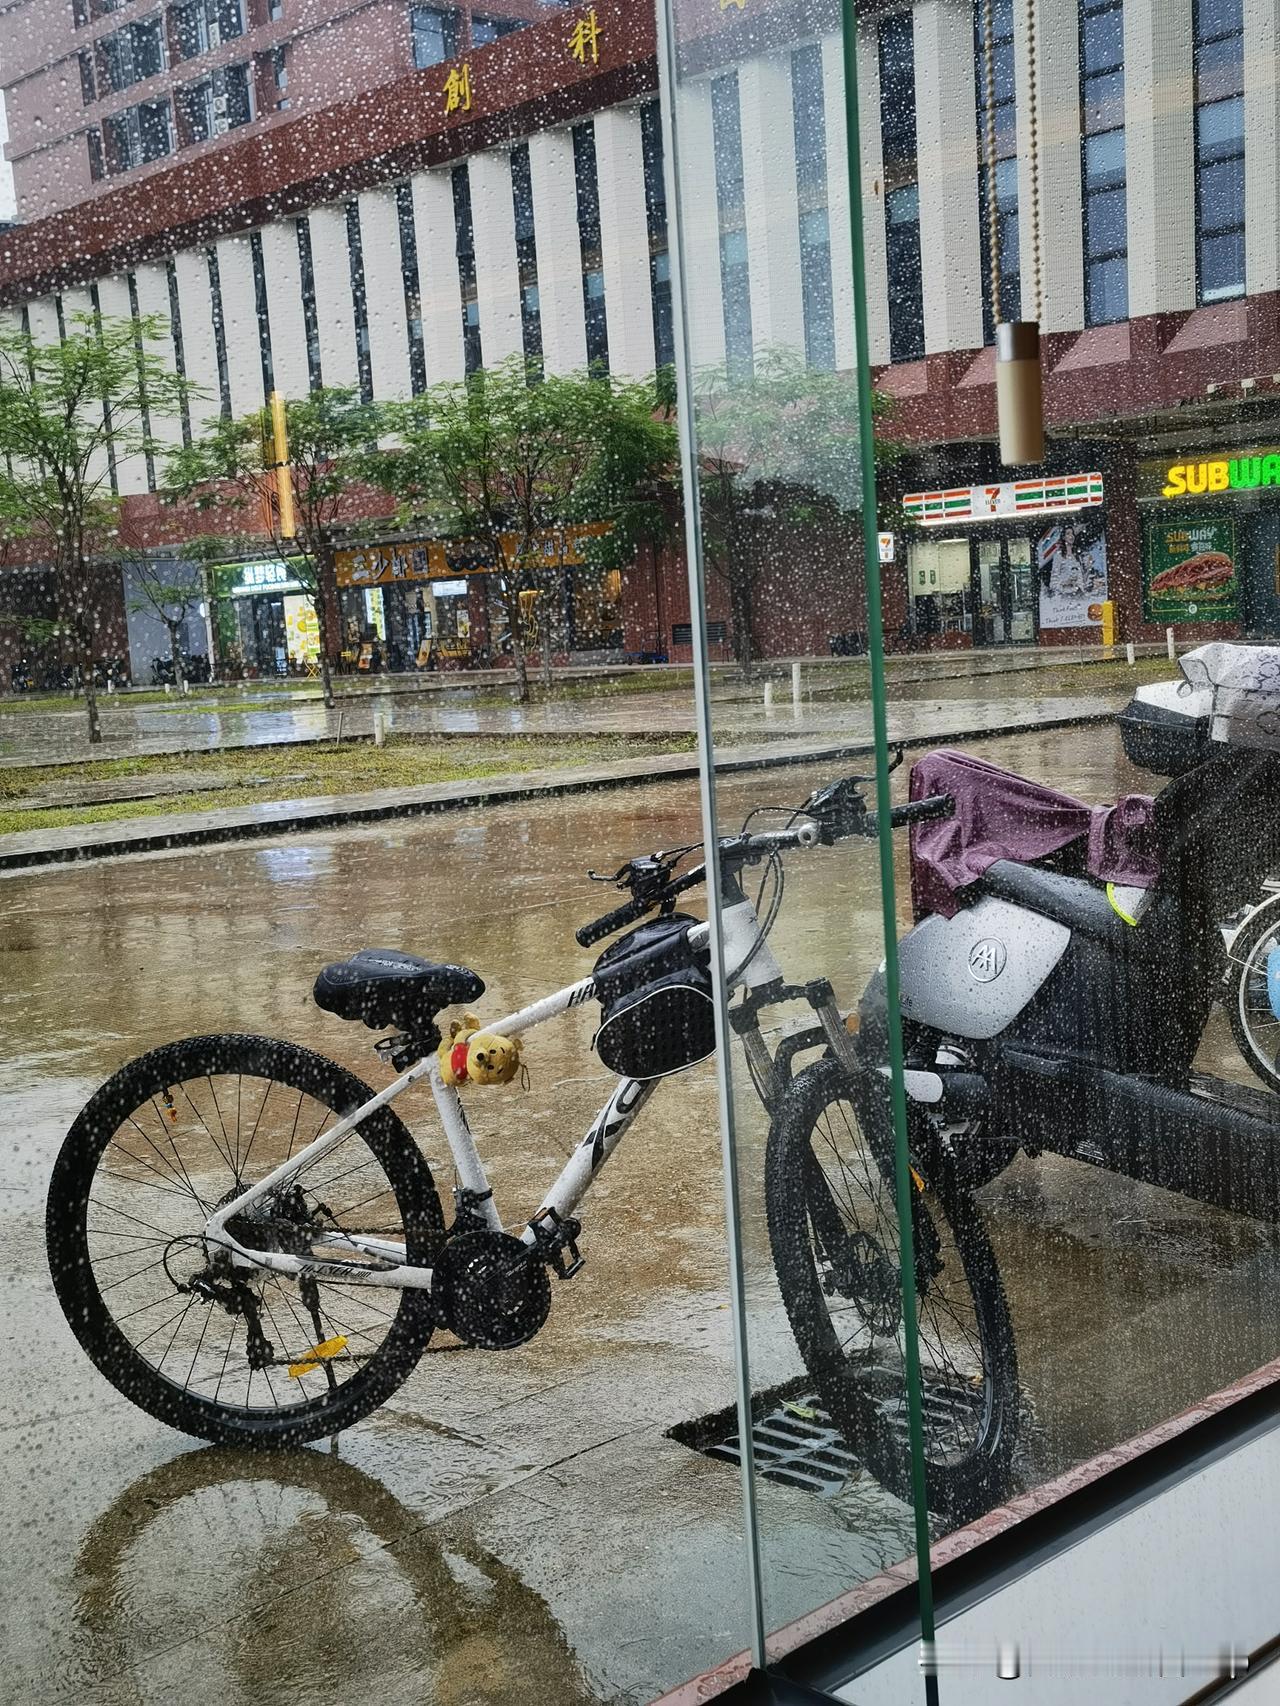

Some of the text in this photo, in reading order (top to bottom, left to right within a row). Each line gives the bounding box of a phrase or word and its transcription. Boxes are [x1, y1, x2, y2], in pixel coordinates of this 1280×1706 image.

[443, 9, 602, 112] 創 科
[1162, 454, 1280, 498] SUBWA
[1165, 527, 1217, 544] SUBWAY
